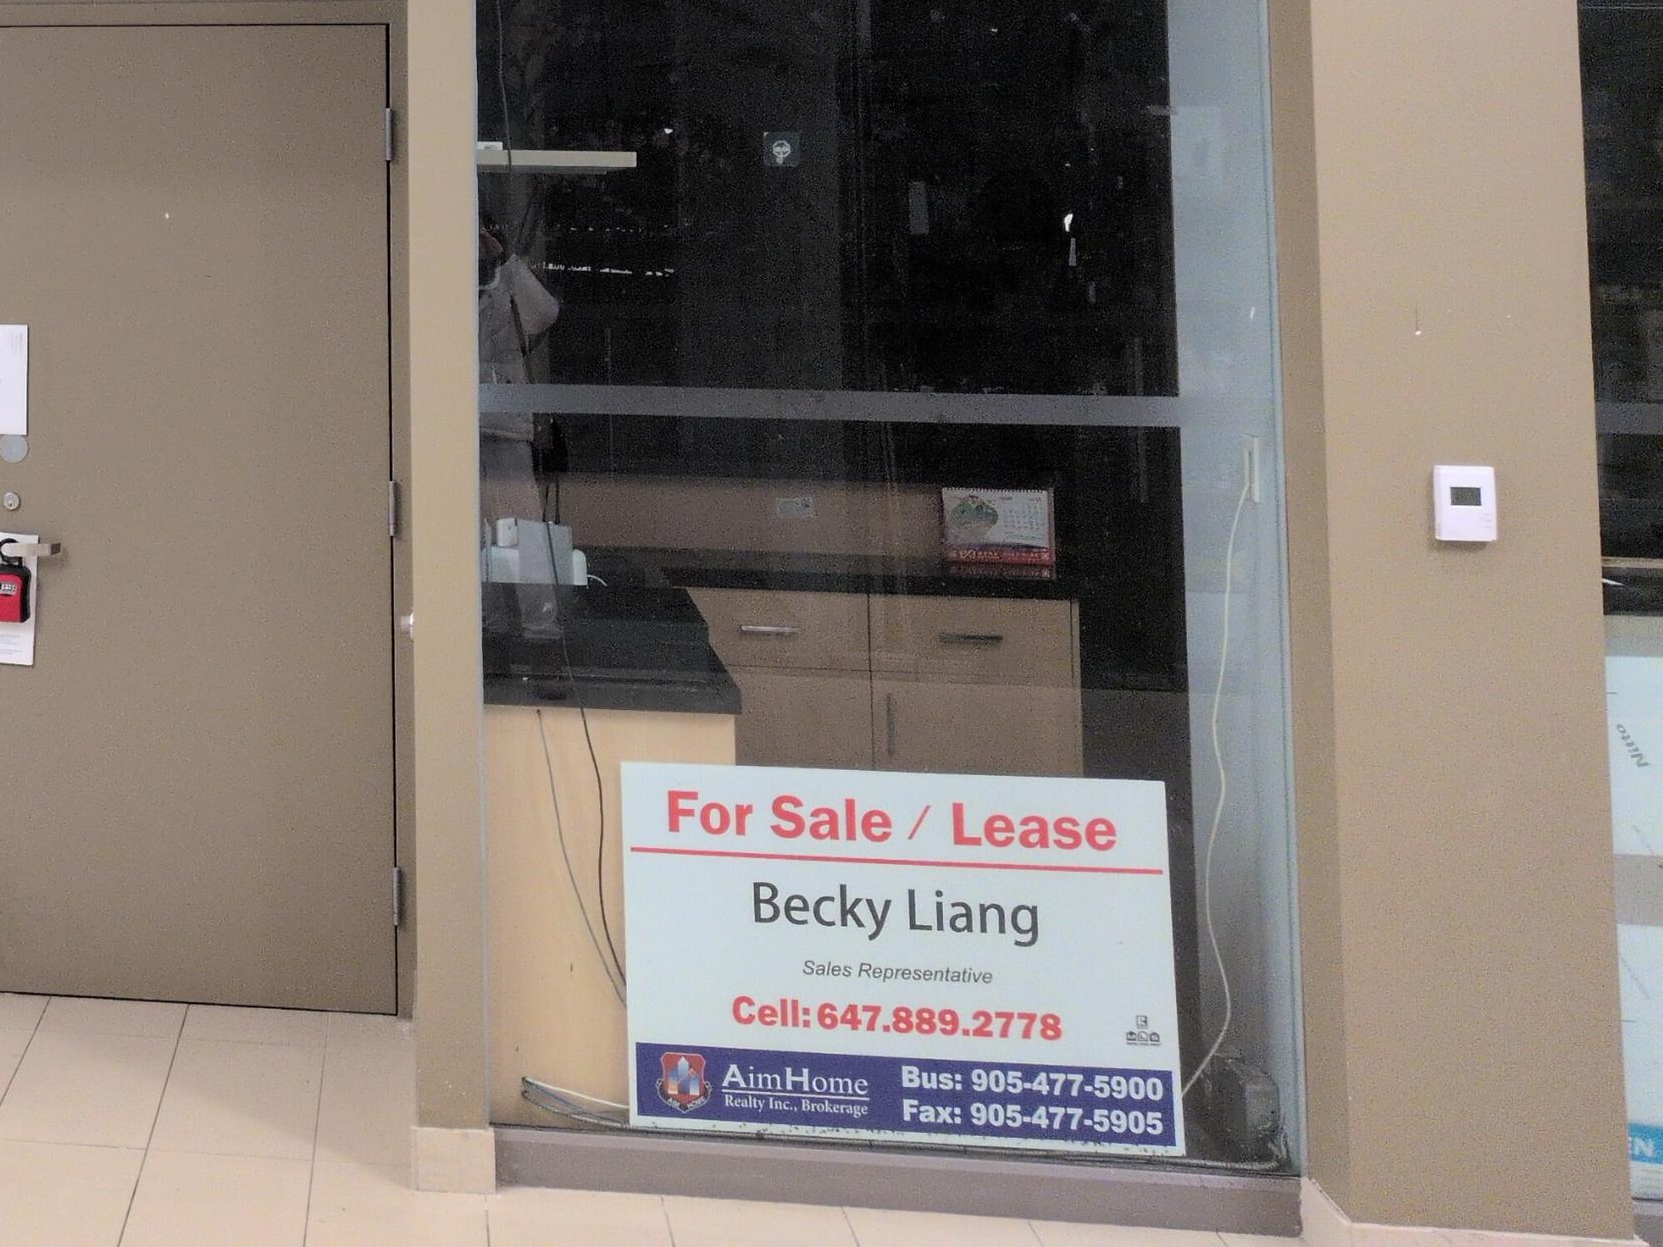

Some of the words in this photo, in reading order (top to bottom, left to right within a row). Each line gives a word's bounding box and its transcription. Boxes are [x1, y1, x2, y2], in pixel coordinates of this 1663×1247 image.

[667, 789, 755, 835] For
[770, 794, 894, 843] Sale
[908, 804, 932, 842] /
[951, 801, 1118, 852] Lease
[752, 881, 893, 941] Becky
[907, 888, 1040, 948] Liang
[802, 959, 853, 979] Sales
[857, 962, 994, 985] Representative
[731, 994, 812, 1028] Cell:
[816, 1001, 1064, 1041] 647.889.2778
[722, 1064, 870, 1097] AimHome
[901, 1065, 963, 1091] Bus:
[971, 1068, 1164, 1101] 905-477-5900
[724, 1092, 766, 1113] Realty
[801, 1098, 869, 1119] Brokerage
[902, 1098, 963, 1126] Fax:
[971, 1102, 1164, 1136] 905-477-5905
